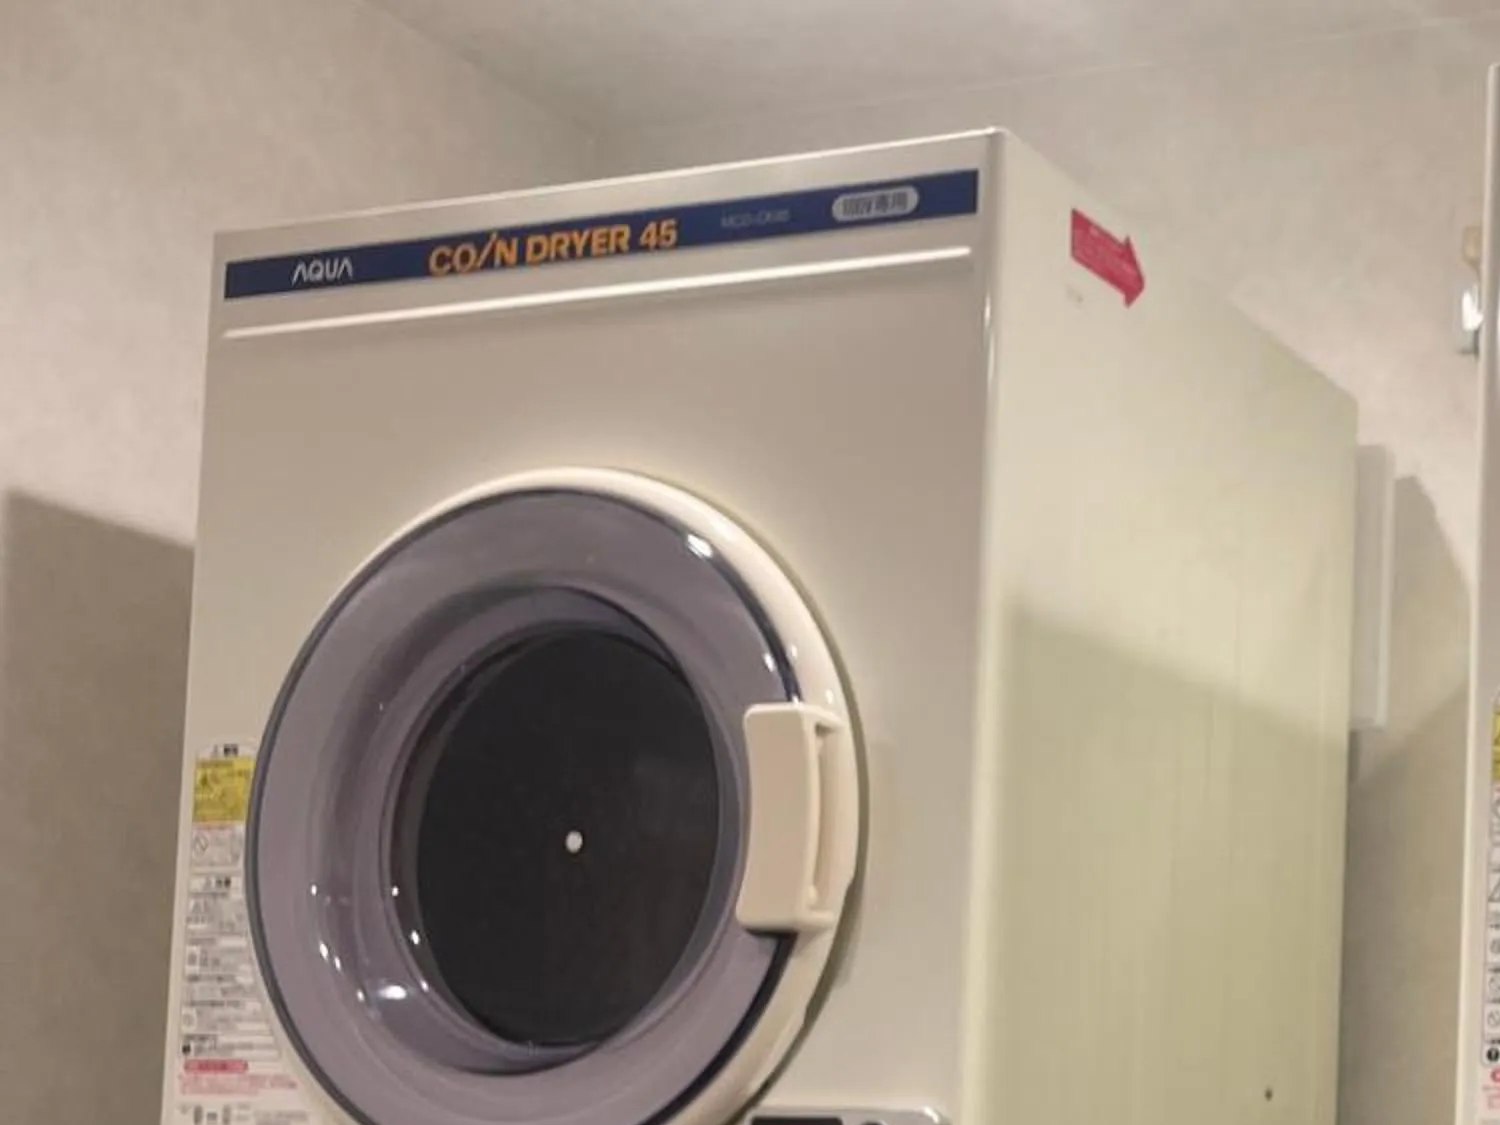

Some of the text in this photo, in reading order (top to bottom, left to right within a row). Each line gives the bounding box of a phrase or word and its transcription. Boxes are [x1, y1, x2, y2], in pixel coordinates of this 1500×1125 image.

[525, 223, 630, 266] DRYER
[639, 218, 679, 251] 45
[291, 256, 354, 286] AQUA
